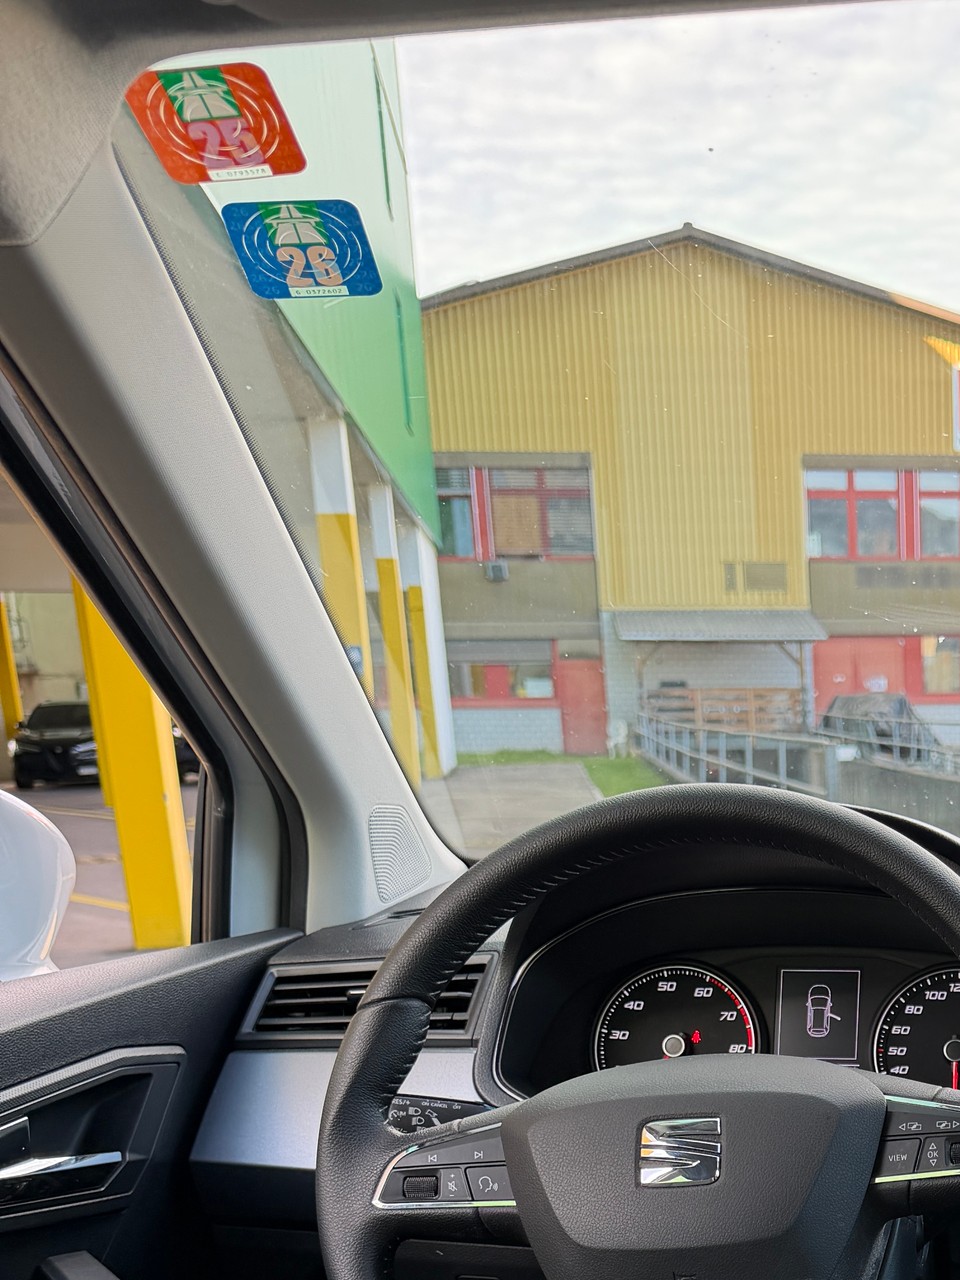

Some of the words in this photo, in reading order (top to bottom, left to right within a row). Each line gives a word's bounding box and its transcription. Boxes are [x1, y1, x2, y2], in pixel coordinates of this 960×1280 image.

[187, 119, 264, 168] 25
[276, 246, 343, 286] 26
[657, 981, 676, 992] 50
[694, 987, 713, 997] 60
[924, 991, 947, 1000] 100
[624, 1001, 644, 1011] 40
[904, 1005, 923, 1014] 80
[719, 1011, 737, 1021] 70
[609, 1030, 629, 1040] 30
[891, 1026, 911, 1035] 60
[729, 1044, 746, 1053] 80
[888, 1047, 907, 1056] 50
[890, 1065, 909, 1074] 40
[888, 1153, 908, 1162] VIEW
[927, 1150, 939, 1158] OK
